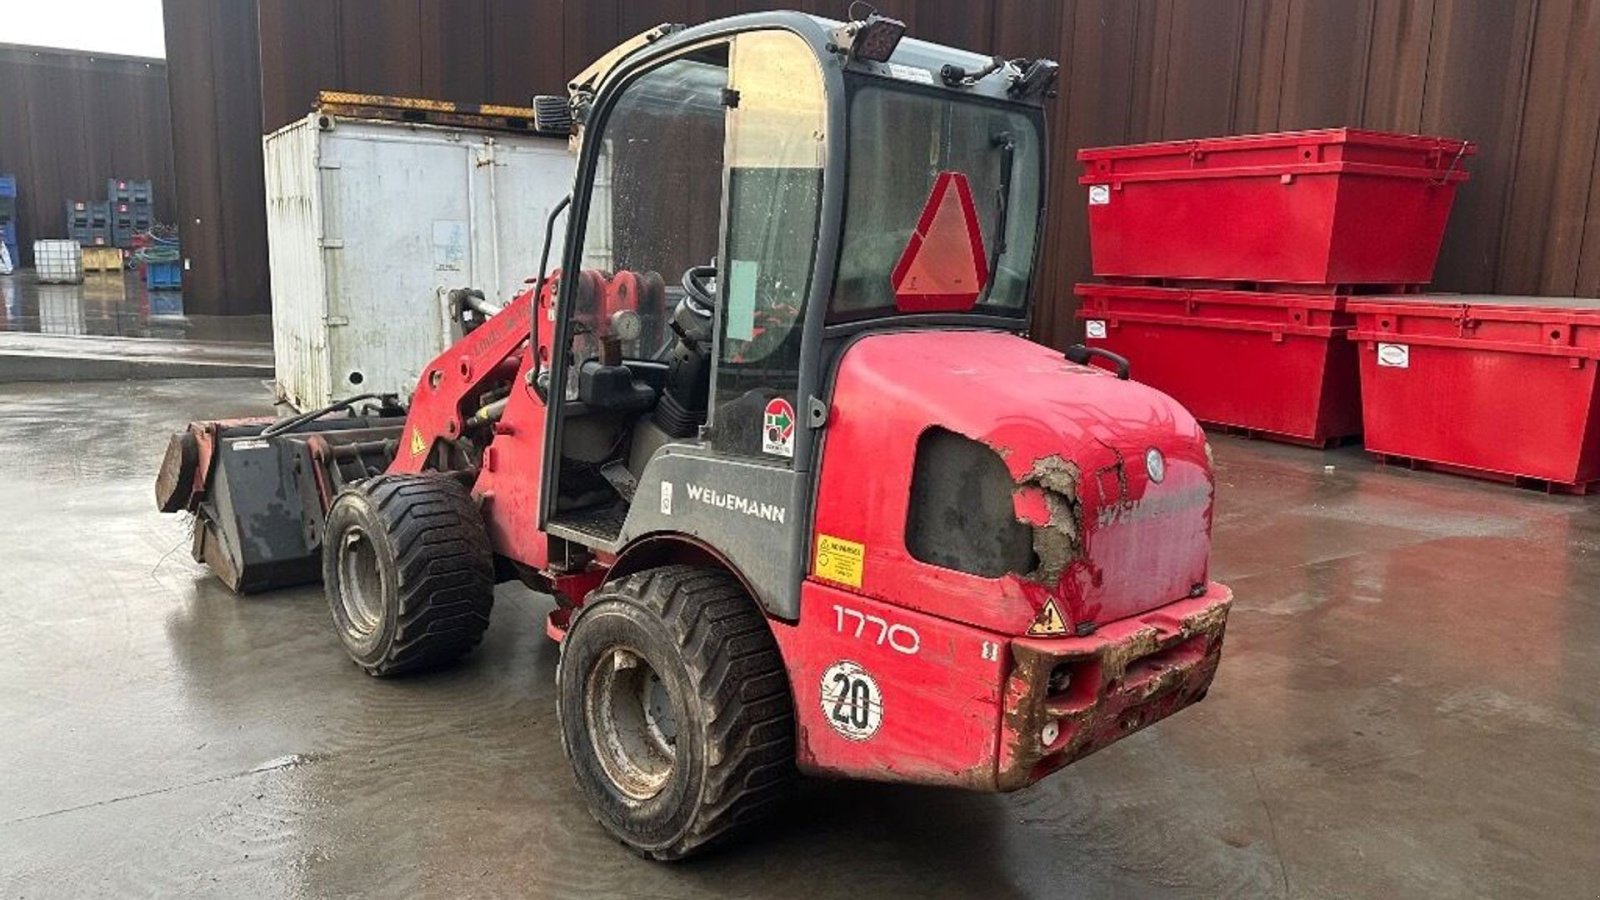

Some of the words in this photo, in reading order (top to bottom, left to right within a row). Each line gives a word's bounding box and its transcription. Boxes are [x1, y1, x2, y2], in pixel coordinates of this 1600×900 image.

[686, 482, 786, 524] WEIDEMANN
[833, 604, 920, 654] 1770
[833, 673, 870, 729] 20
